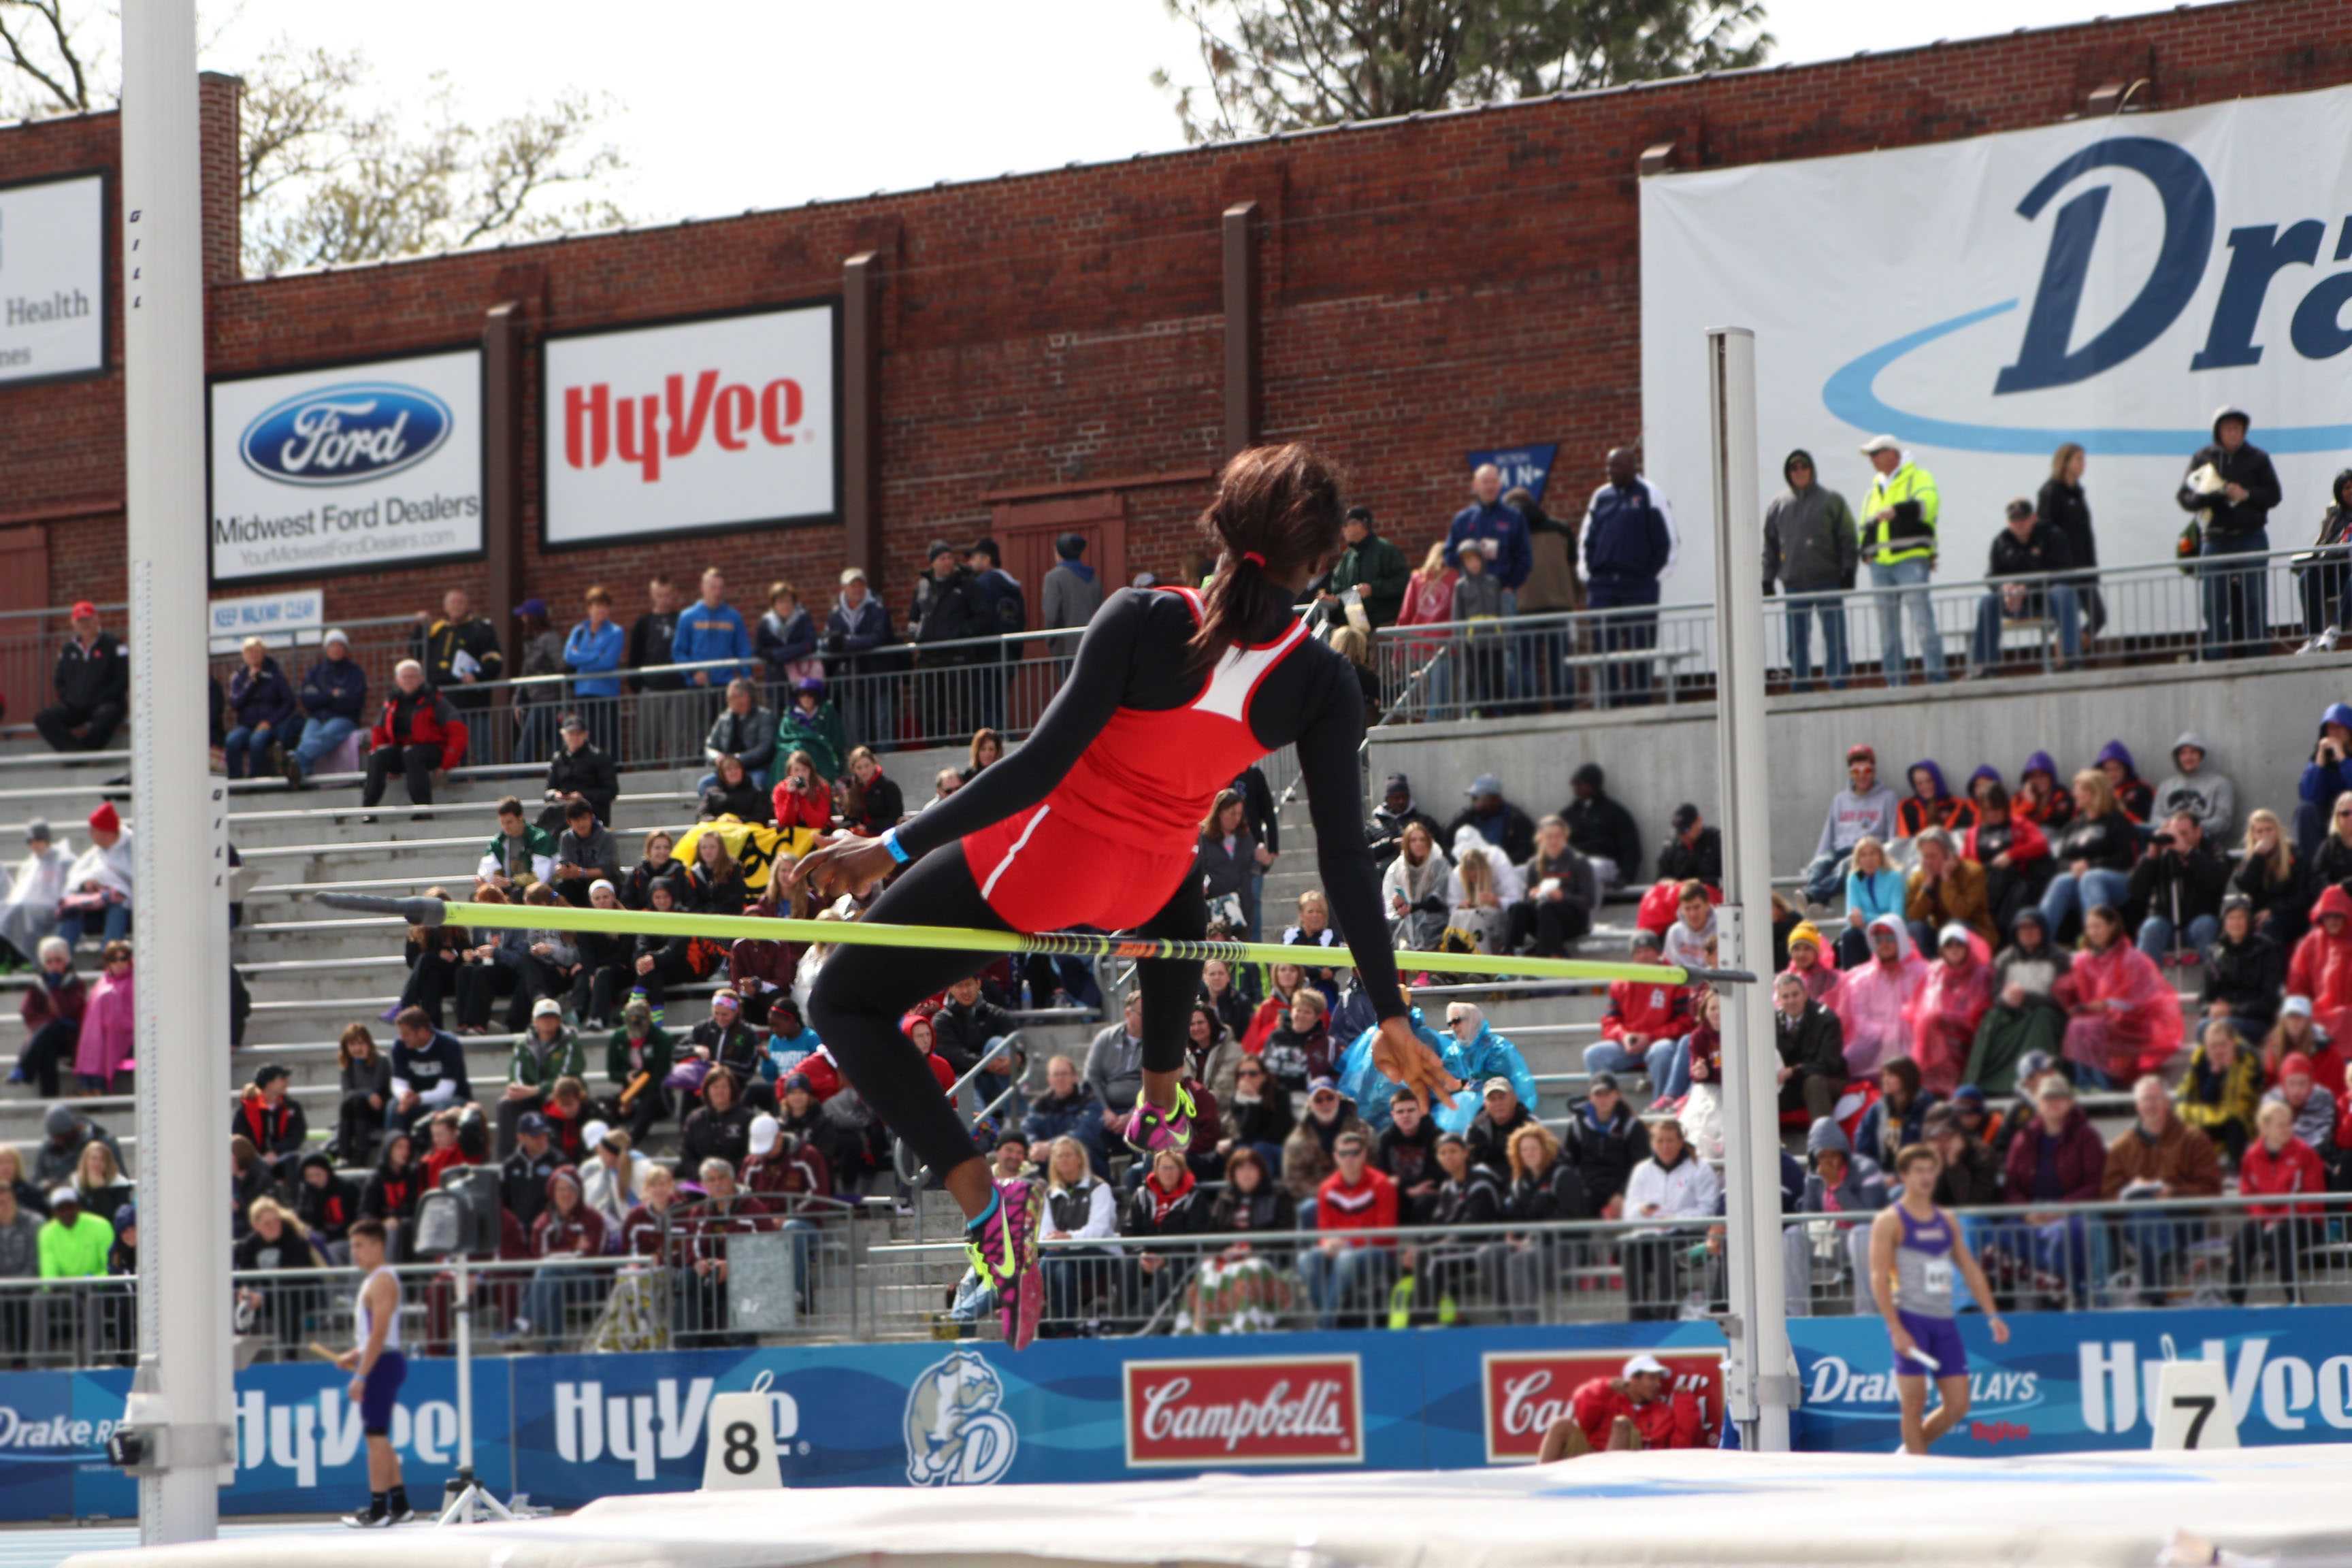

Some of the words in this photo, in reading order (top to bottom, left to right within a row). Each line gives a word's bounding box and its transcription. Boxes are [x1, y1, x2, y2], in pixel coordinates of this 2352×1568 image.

[130, 210, 142, 309] GILL
[6, 287, 89, 327] Health
[282, 398, 410, 472] Ford
[565, 370, 803, 483] HyVee
[214, 509, 315, 544] Midwest
[322, 501, 379, 532] Ford
[386, 493, 478, 526] Dealers
[555, 1378, 798, 1480] HyVe
[723, 1421, 760, 1475] 8
[1142, 1377, 1345, 1450] Campbell's
[2172, 1396, 2217, 1450] 7
